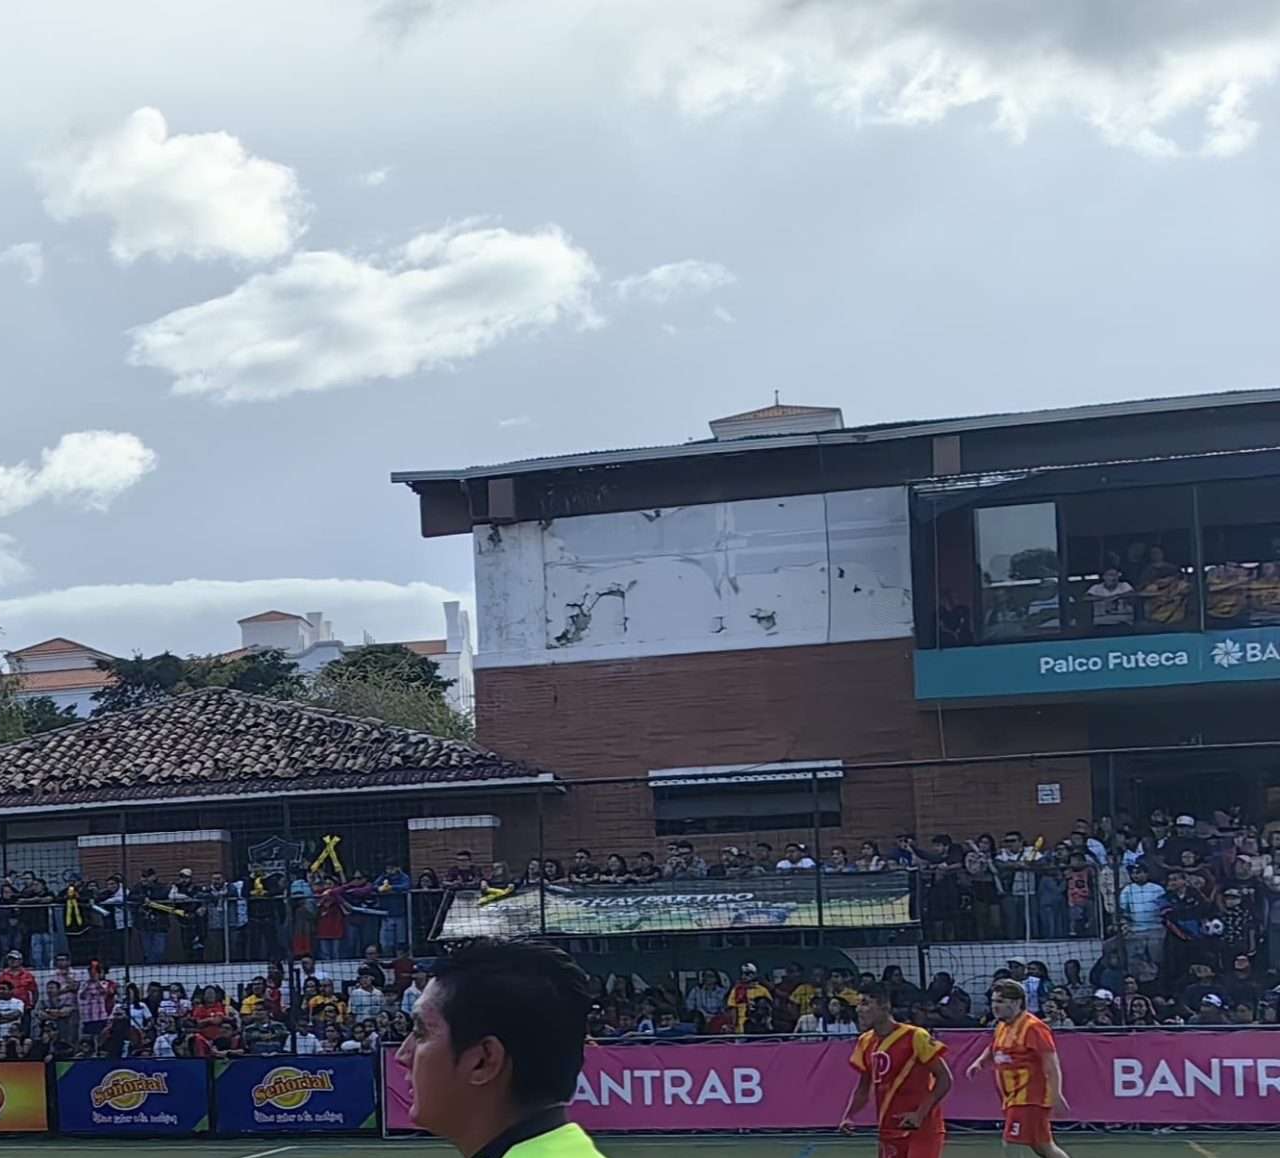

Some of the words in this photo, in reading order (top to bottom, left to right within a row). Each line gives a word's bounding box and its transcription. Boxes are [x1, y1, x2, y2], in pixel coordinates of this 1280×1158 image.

[1040, 656, 1102, 674] Palco
[1108, 651, 1189, 669] Futeca
[571, 1068, 763, 1106] ANTRAB
[1010, 1122, 1020, 1136] 3
